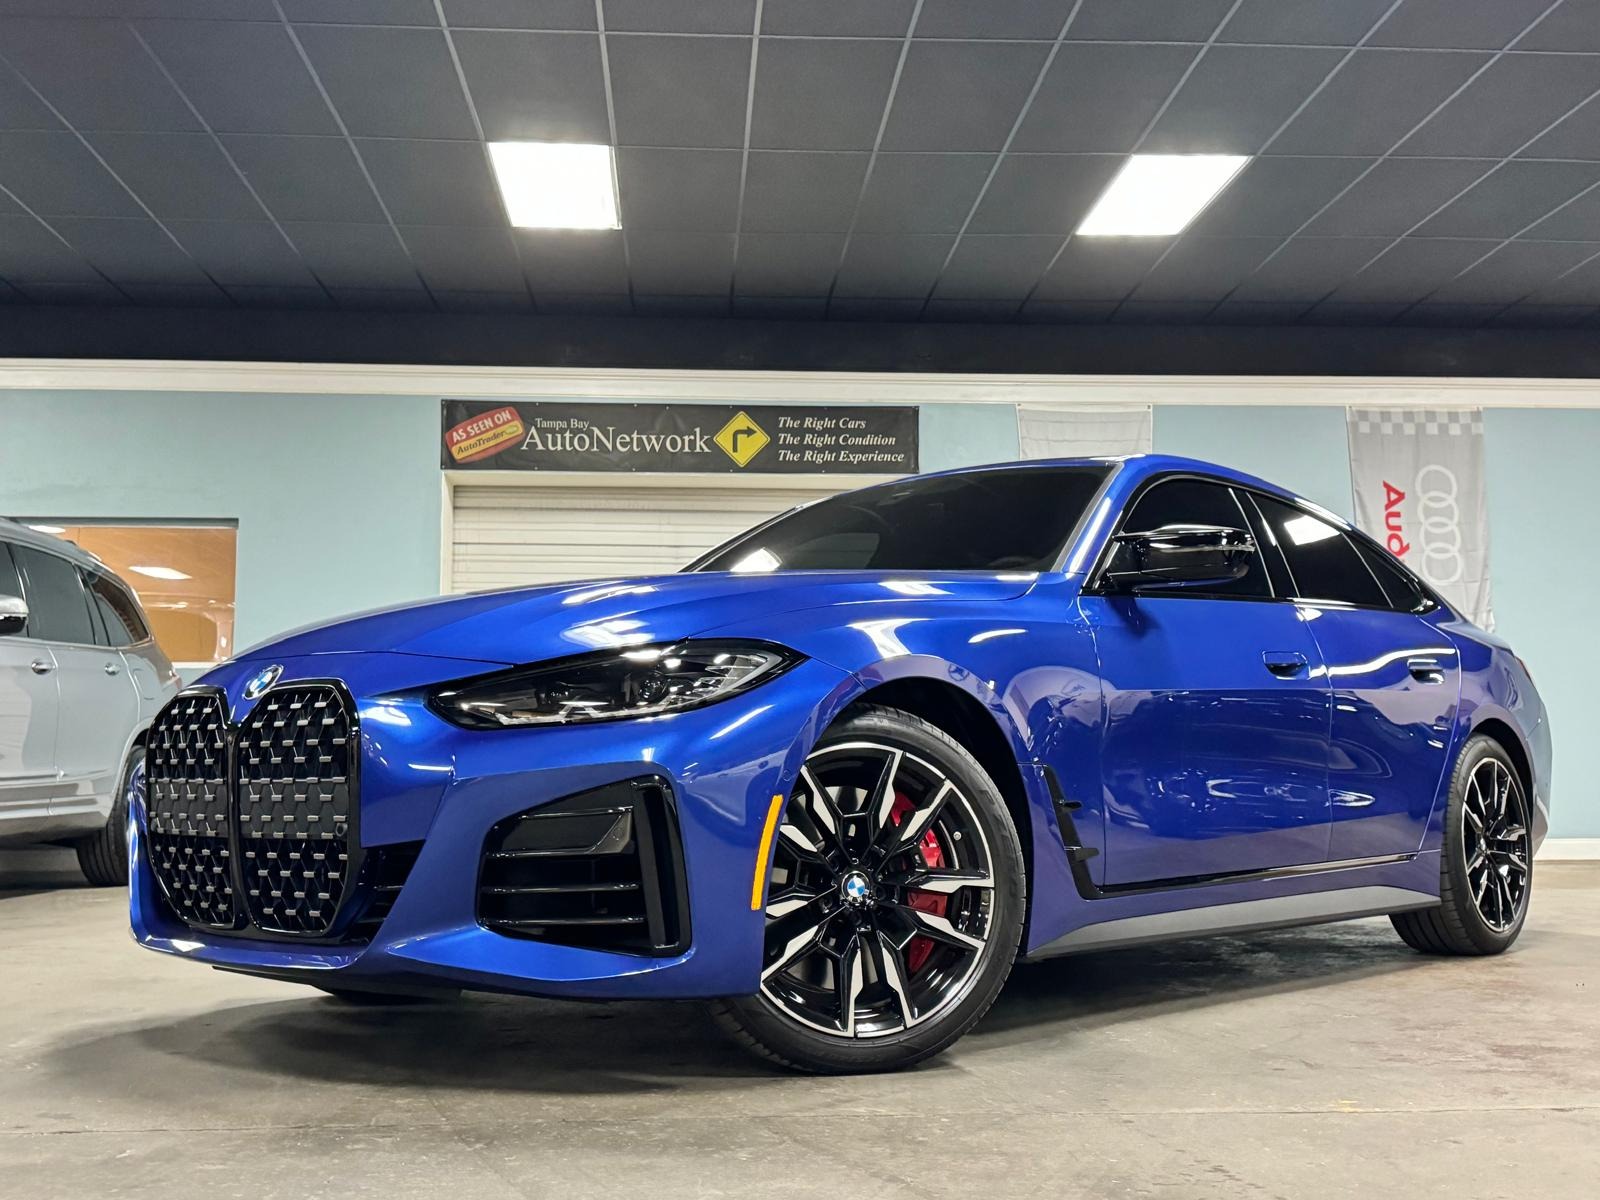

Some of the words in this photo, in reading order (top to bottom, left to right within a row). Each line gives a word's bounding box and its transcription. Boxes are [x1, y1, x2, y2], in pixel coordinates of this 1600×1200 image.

[452, 428, 467, 443] AS
[467, 417, 494, 436] SEEN
[494, 410, 512, 424] ON
[535, 418, 567, 430] Tampa
[570, 418, 590, 430] Bay
[778, 417, 800, 428] The
[803, 417, 836, 431] Right
[839, 417, 867, 429] Cars
[457, 430, 505, 455] AutoTrader
[520, 425, 712, 453] AutoNetwork
[778, 433, 800, 445] The
[803, 433, 836, 448] Right
[839, 434, 896, 446] Condition
[778, 450, 800, 461] The
[803, 450, 836, 464] Right
[838, 450, 904, 464] Experience
[1382, 480, 1410, 558] Aud
